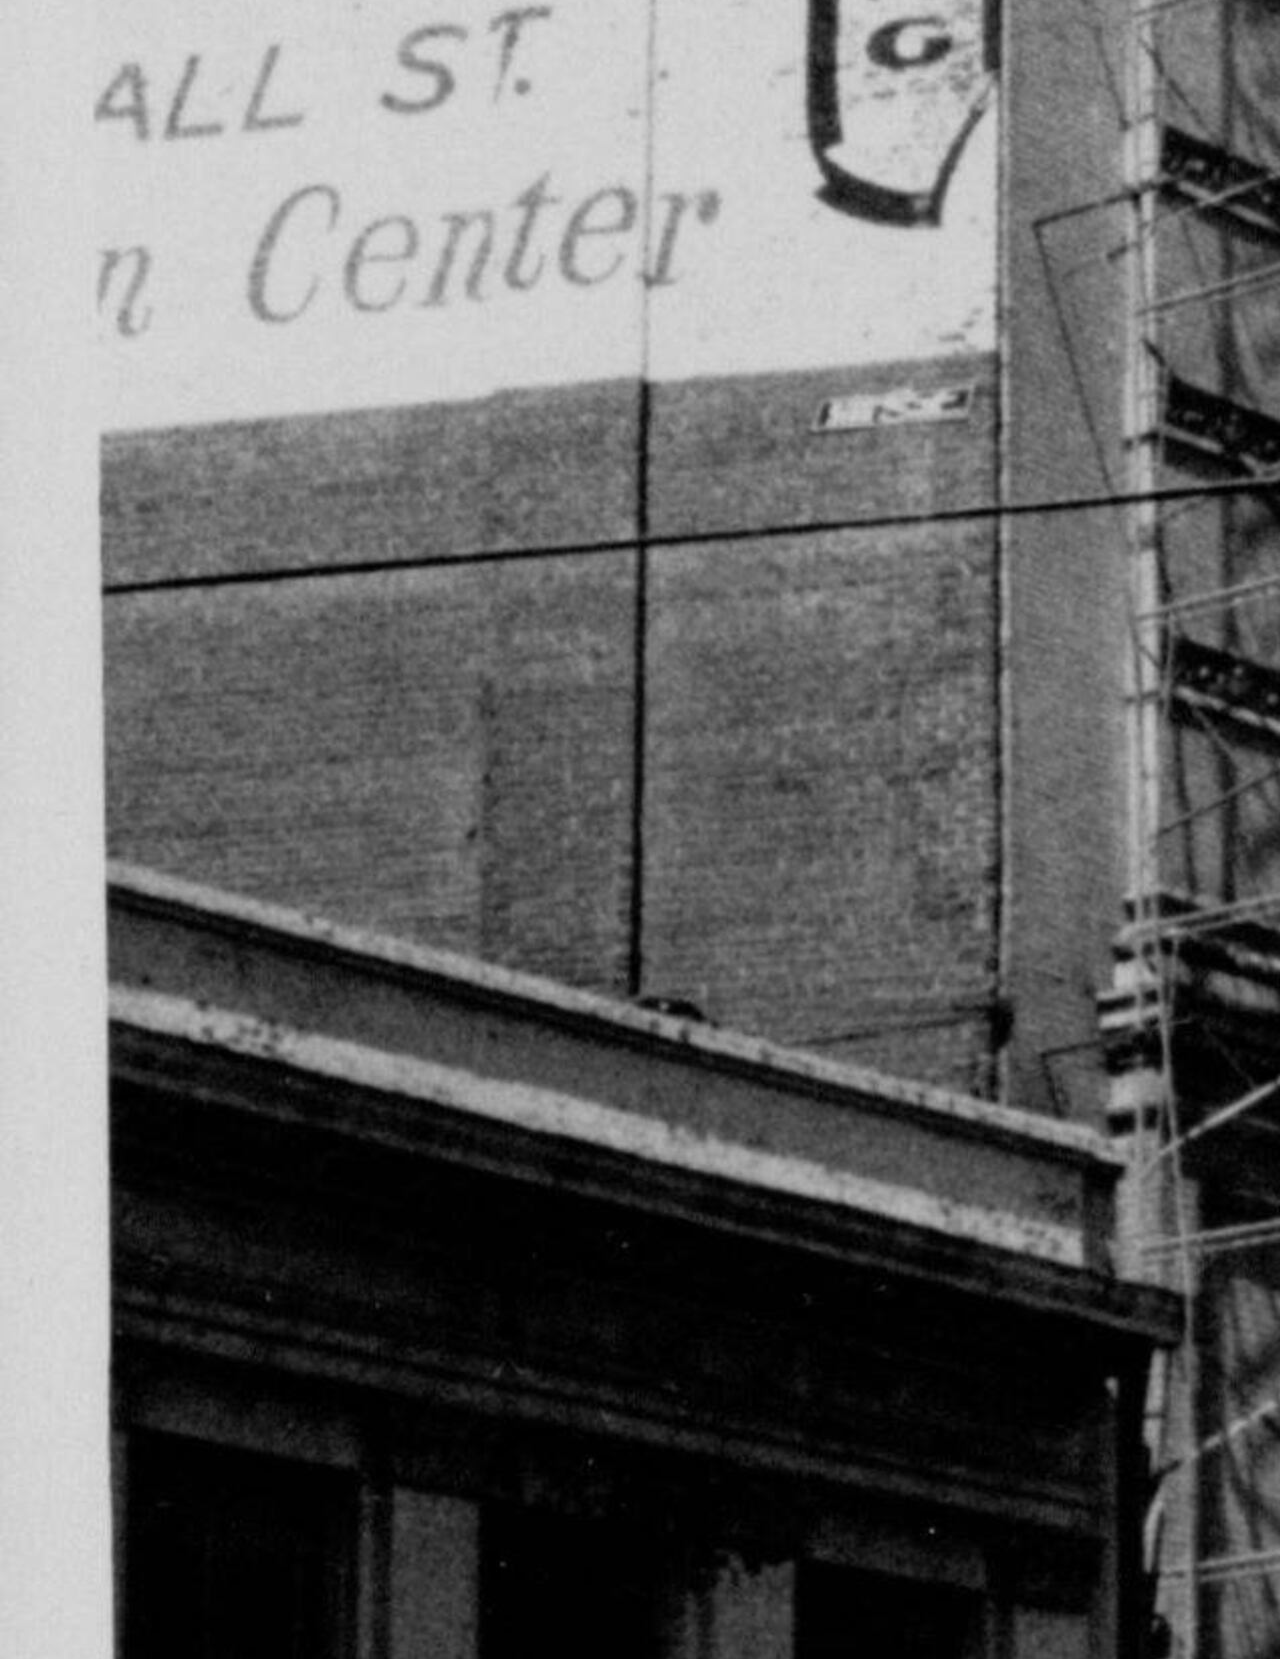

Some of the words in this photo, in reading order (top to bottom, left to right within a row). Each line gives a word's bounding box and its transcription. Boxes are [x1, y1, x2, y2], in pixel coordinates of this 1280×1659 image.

[93, 44, 304, 141] ALL
[379, 4, 554, 116] ST.
[244, 168, 724, 325] Center
